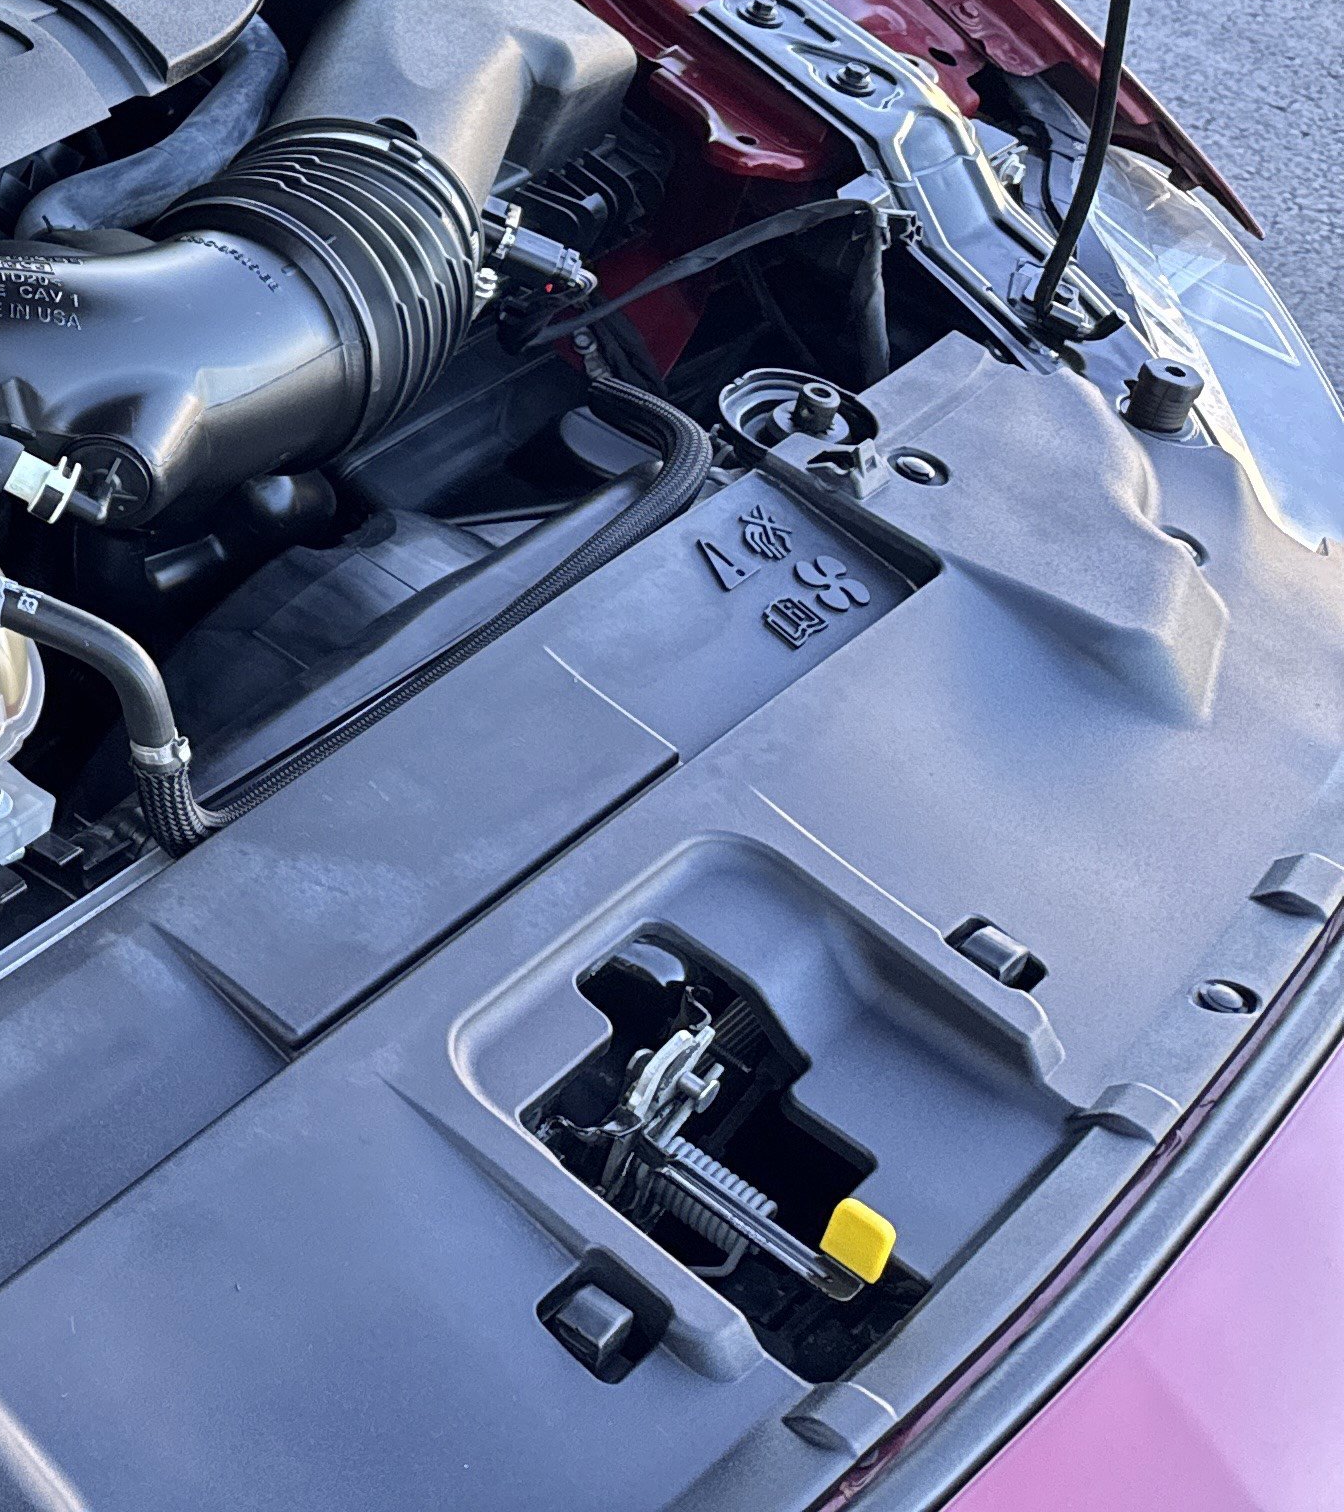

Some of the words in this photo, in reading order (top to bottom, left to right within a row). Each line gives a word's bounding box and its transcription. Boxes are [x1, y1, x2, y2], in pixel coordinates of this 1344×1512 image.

[19, 285, 63, 303] CAV
[9, 302, 30, 320] IN
[37, 305, 82, 331] USA
